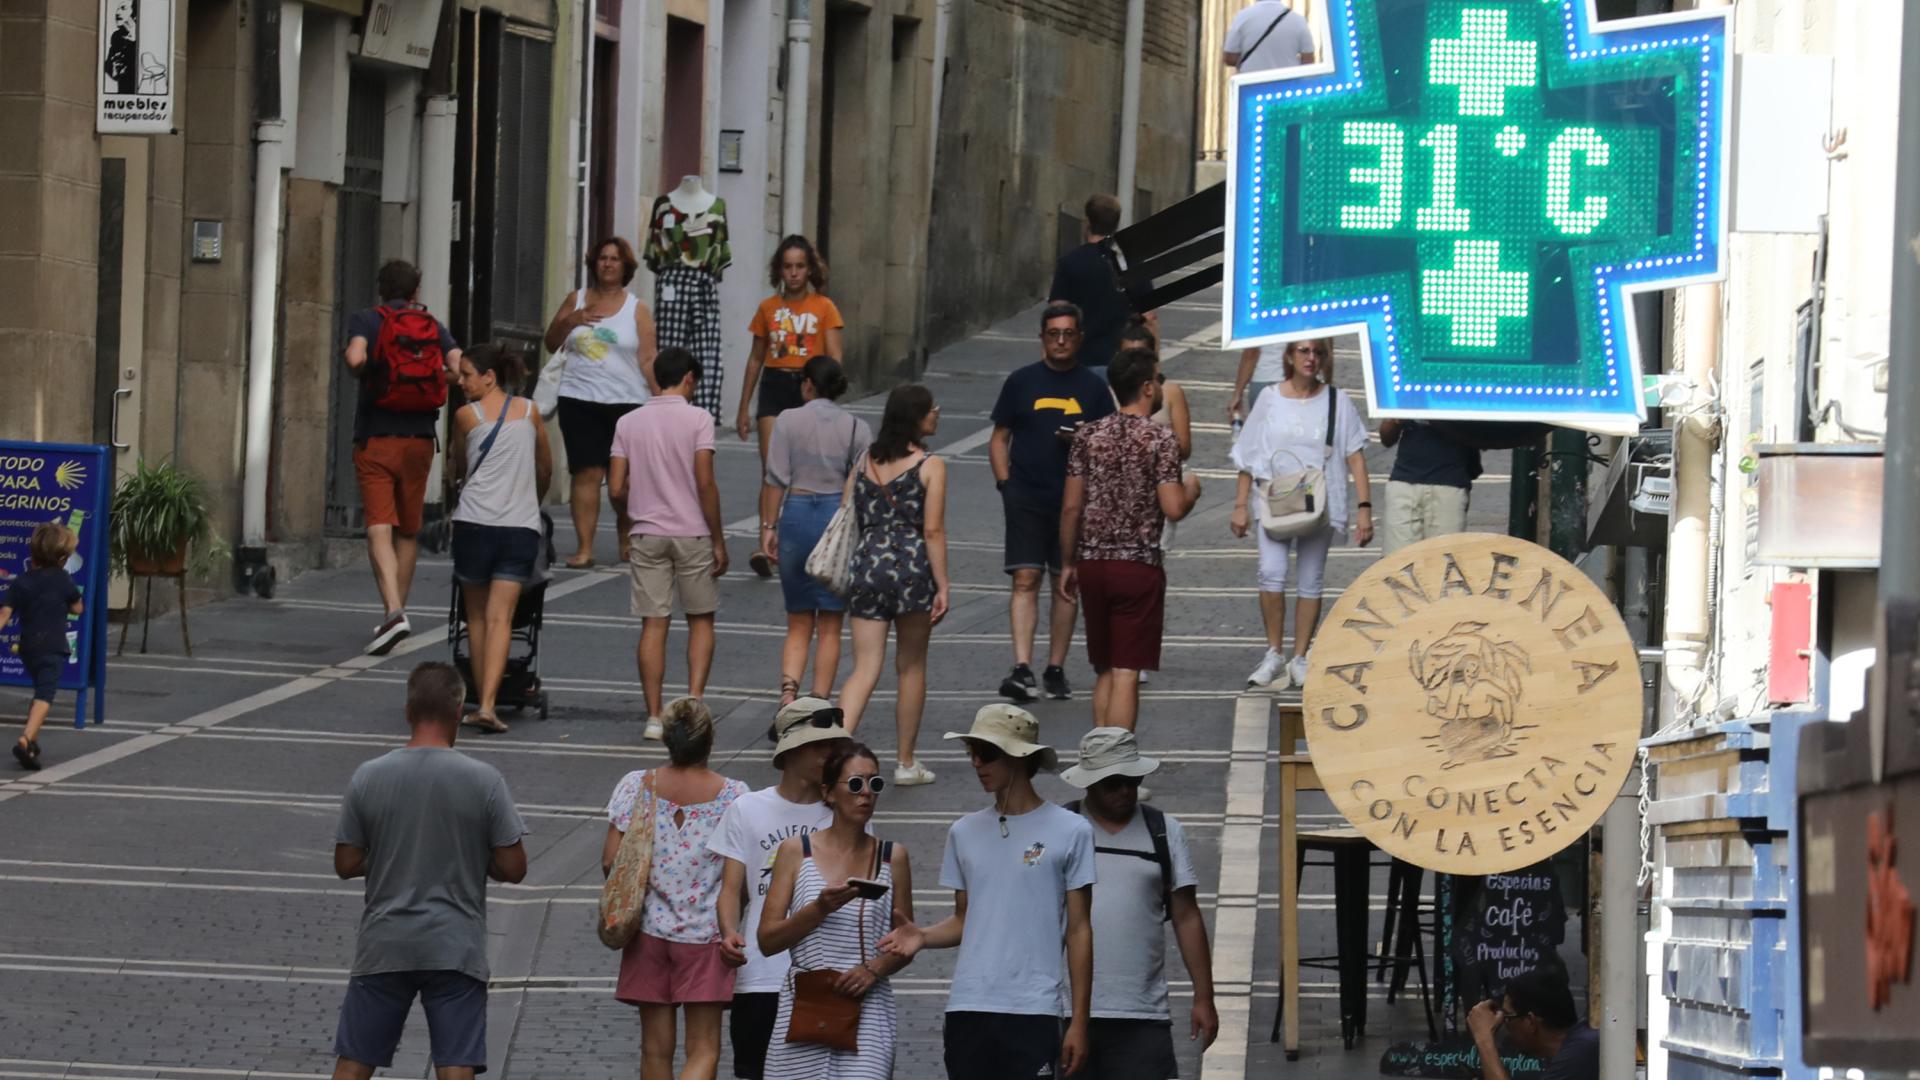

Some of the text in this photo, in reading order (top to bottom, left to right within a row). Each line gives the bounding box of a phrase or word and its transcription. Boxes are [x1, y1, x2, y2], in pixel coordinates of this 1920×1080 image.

[103, 98, 167, 111] muebles
[103, 111, 167, 123] recuperados
[1321, 551, 1620, 732] CANNAENEA
[1351, 742, 1617, 856] CON LA ESENCIA
[1402, 755, 1567, 816] CONECTA
